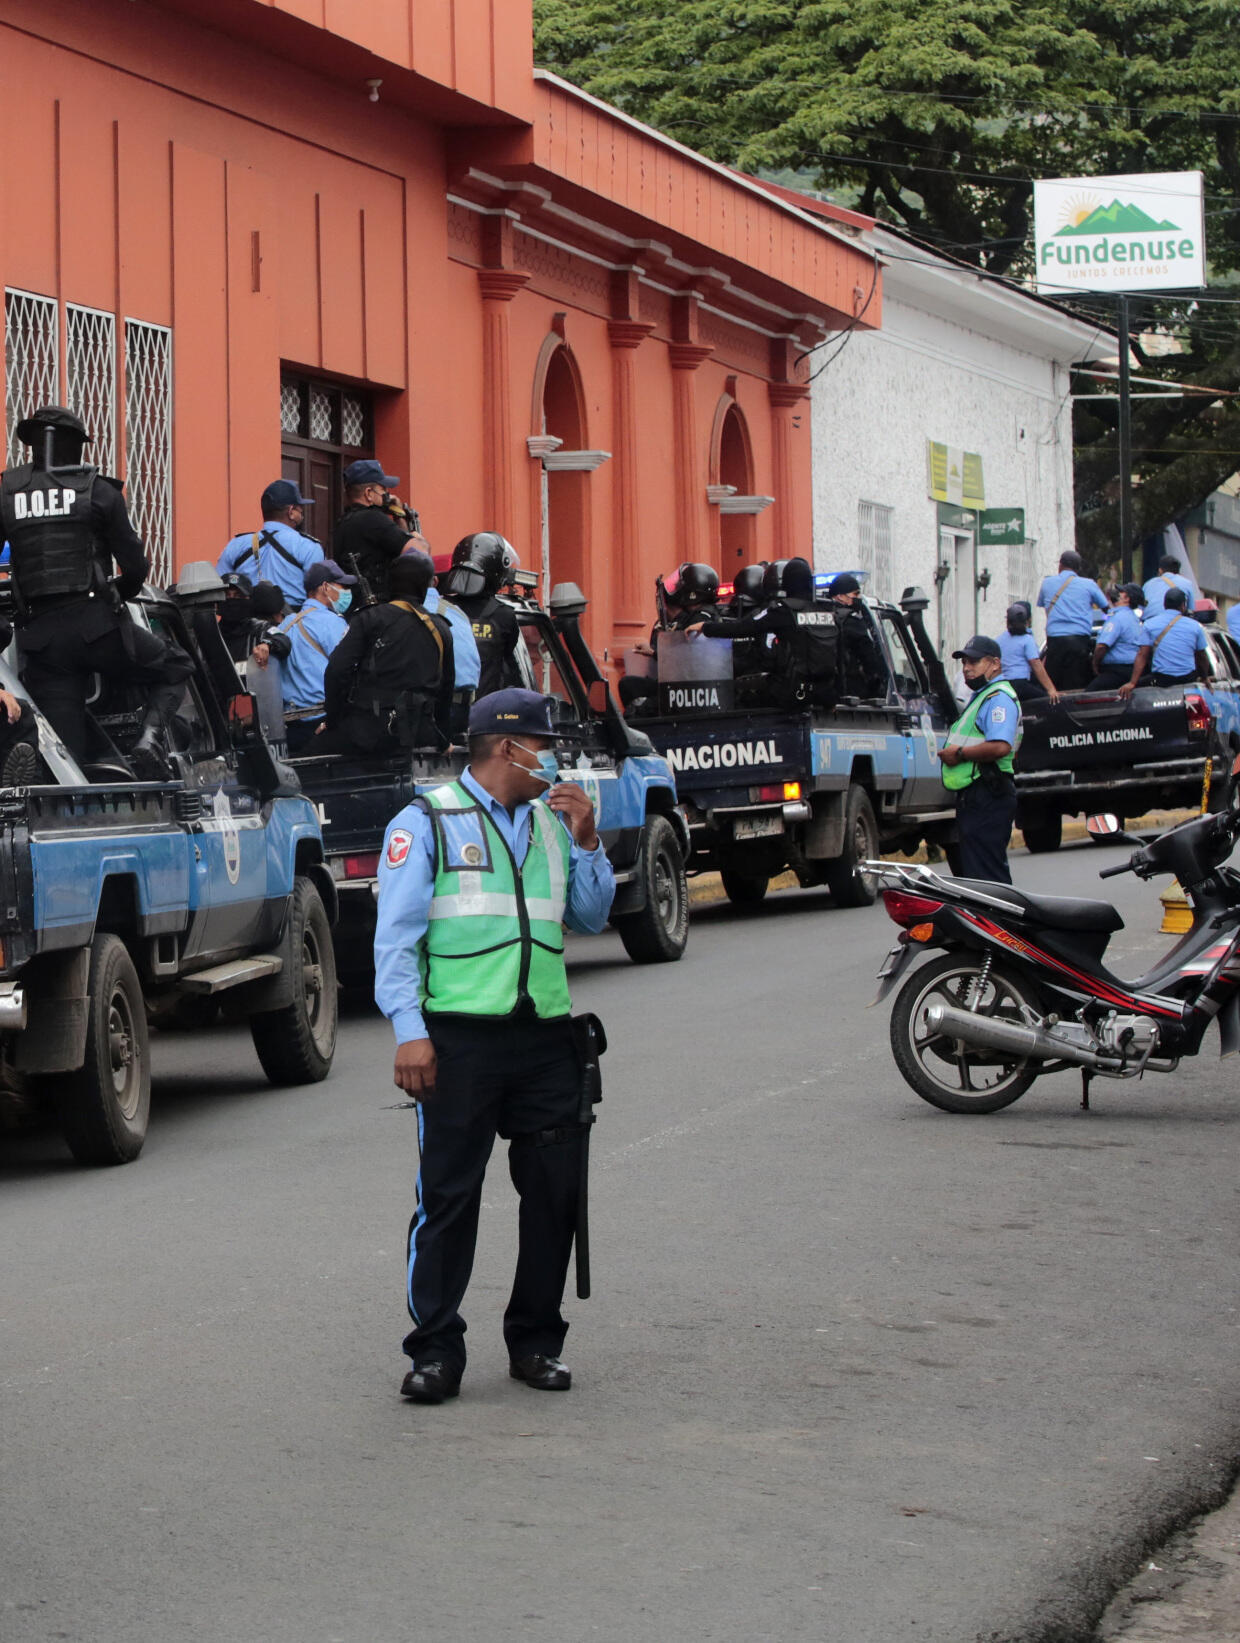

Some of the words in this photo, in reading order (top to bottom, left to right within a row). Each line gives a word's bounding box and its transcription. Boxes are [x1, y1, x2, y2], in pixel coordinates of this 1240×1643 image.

[1040, 237, 1195, 266] Fundenuse
[1113, 265, 1169, 277] CRECEMOS
[14, 488, 77, 520] D.O.E.P
[668, 687, 720, 708] POLICIA
[1049, 732, 1094, 749] POLICIA
[1096, 727, 1154, 744] NACIONAL
[666, 740, 784, 771] NACIONAL
